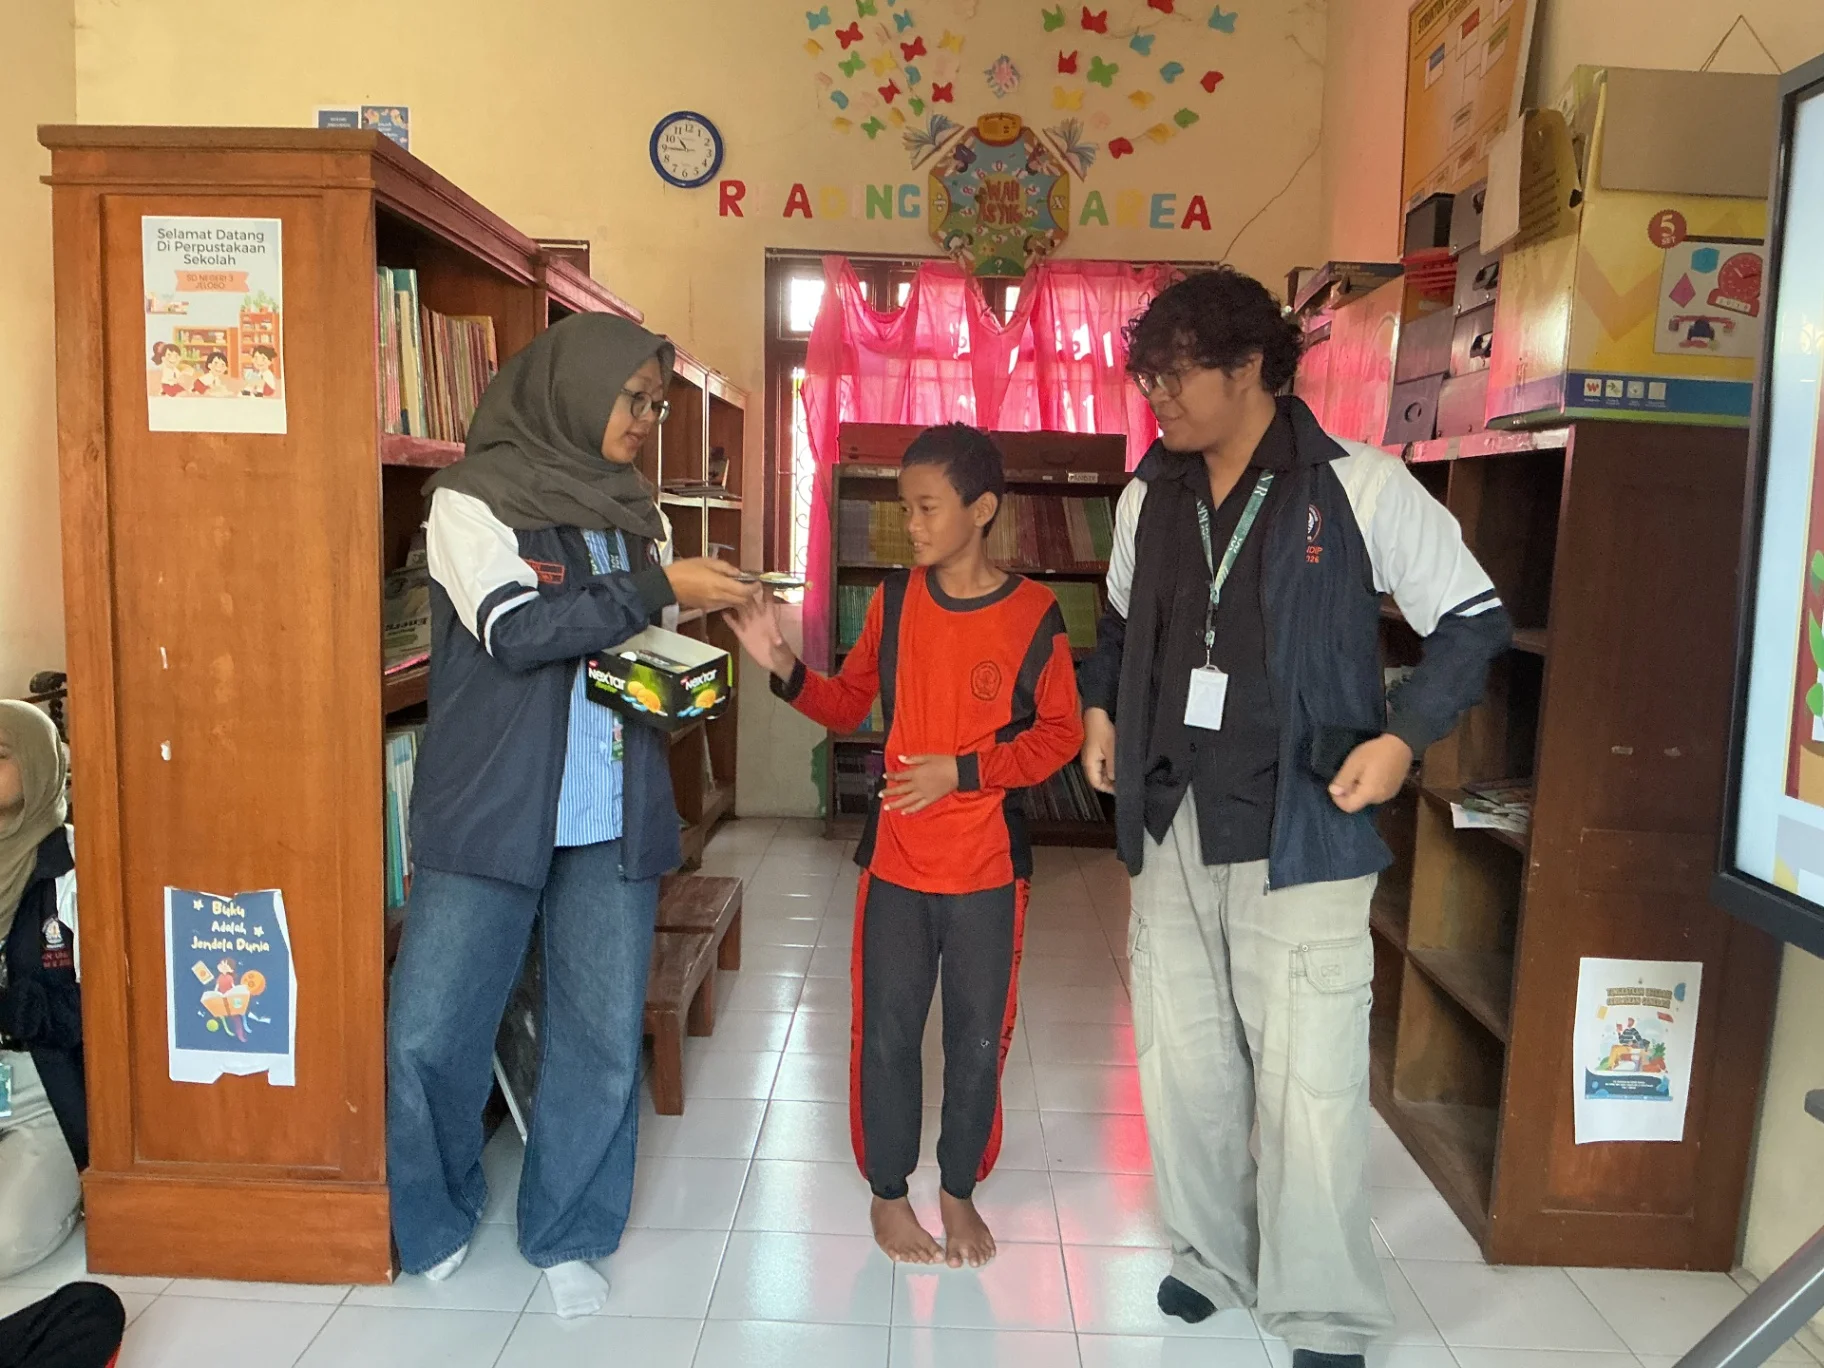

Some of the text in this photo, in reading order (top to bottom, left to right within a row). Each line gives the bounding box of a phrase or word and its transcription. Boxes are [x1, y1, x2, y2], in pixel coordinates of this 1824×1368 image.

[674, 126, 682, 135] 11
[684, 124, 694, 133] 12
[665, 135, 676, 143] 10
[1079, 190, 1211, 230] AREA
[1661, 214, 1675, 237] 5
[157, 228, 265, 243] Selamat Datang
[157, 241, 266, 255] Di Perpustakaan
[183, 254, 236, 266] Sekolah
[211, 900, 245, 918] Buku
[211, 921, 247, 935] Adalah
[191, 935, 270, 953] Jendela Dunia
